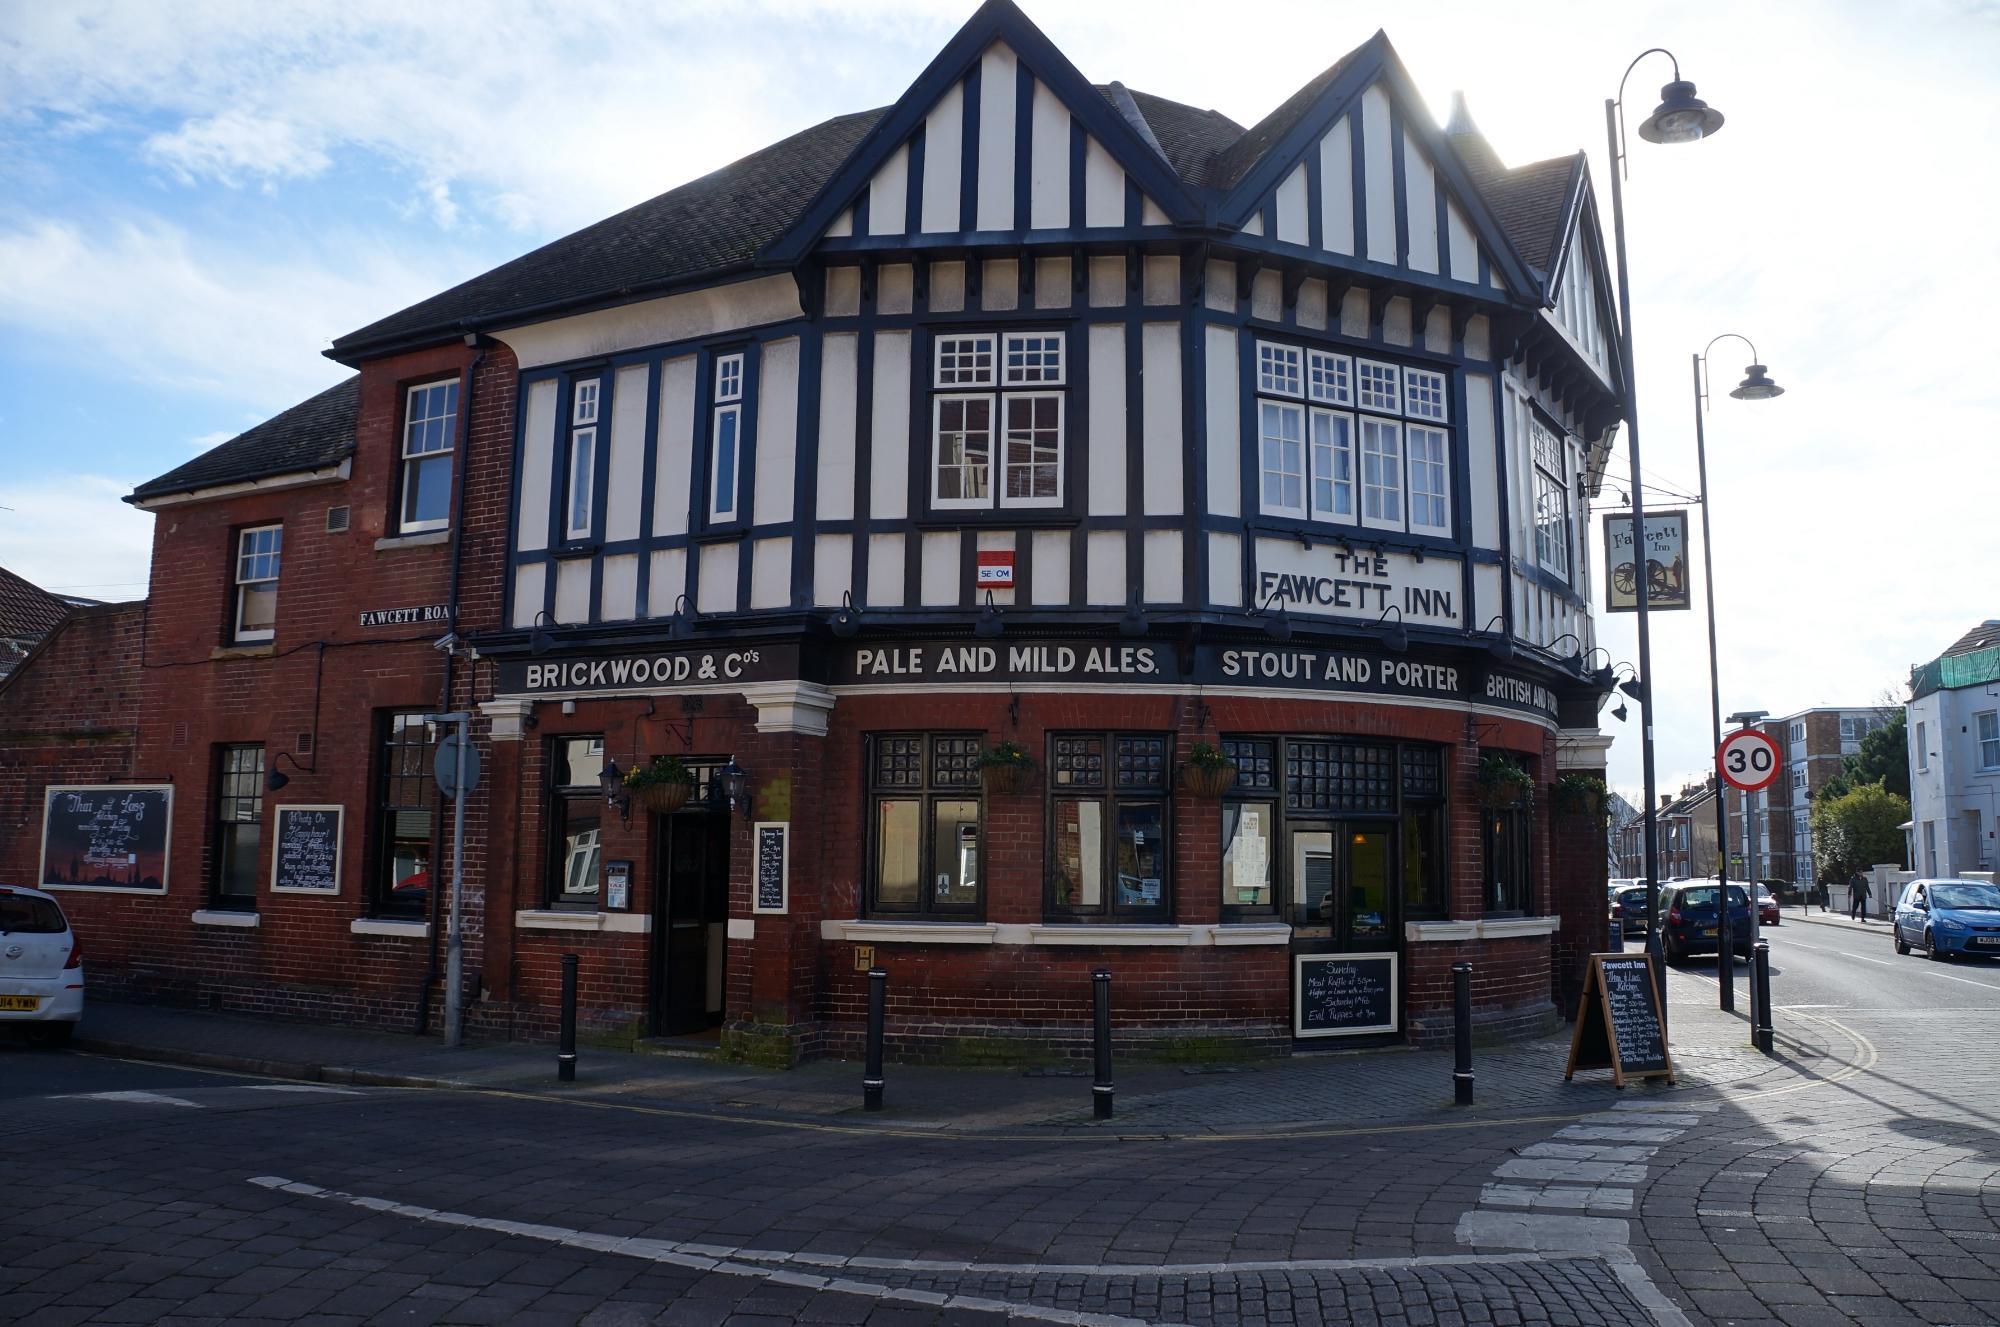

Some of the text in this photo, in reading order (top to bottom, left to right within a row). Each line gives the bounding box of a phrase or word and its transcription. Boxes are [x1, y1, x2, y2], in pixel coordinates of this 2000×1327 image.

[1612, 527, 1678, 549] Facett
[1653, 541, 1670, 552] Inn
[1335, 552, 1388, 577] THE
[1260, 571, 1457, 619] FAWCETT INN.
[360, 608, 419, 626] FAWCETT
[526, 655, 690, 688] BRICKWOOD
[697, 654, 718, 680] &
[856, 646, 1160, 675] PALE AND MILD ALES.
[1222, 650, 1459, 692] STOUT AND PORTER
[1486, 673, 1532, 705] BRITISH
[1727, 747, 1772, 773] 30
[1601, 961, 1647, 970] Fawcett Inn
